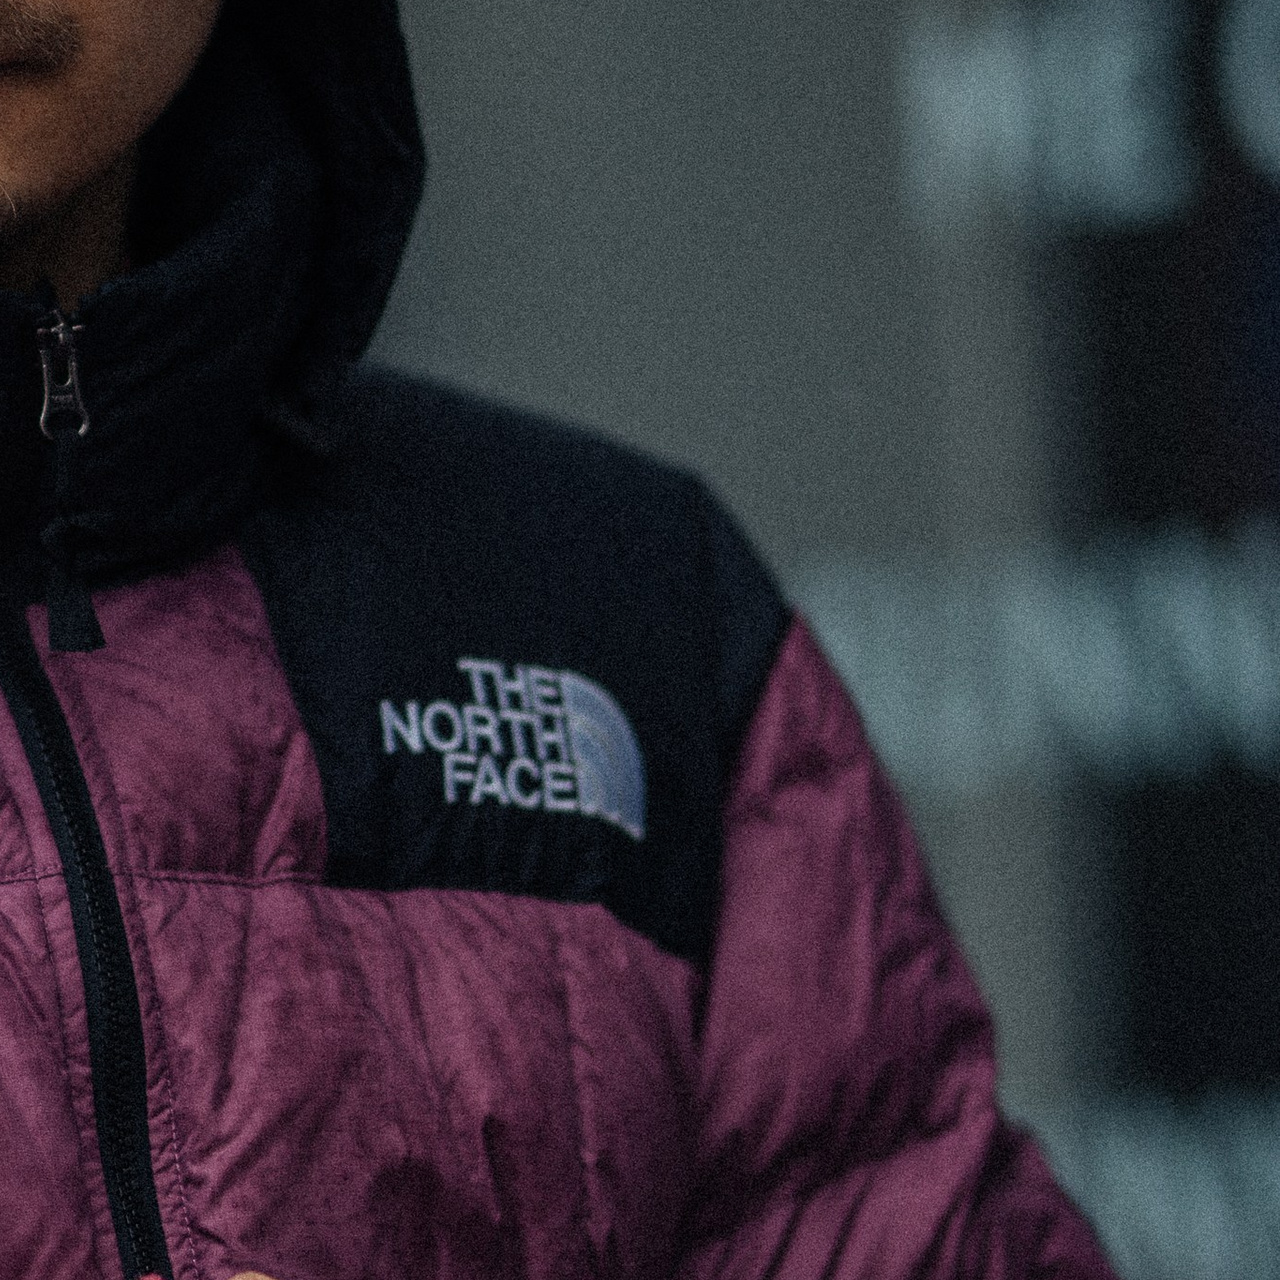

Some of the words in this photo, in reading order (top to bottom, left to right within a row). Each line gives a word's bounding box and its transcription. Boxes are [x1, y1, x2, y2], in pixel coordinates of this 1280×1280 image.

[457, 657, 564, 716] THE
[379, 700, 570, 761] NORTH
[443, 752, 578, 811] FACE
